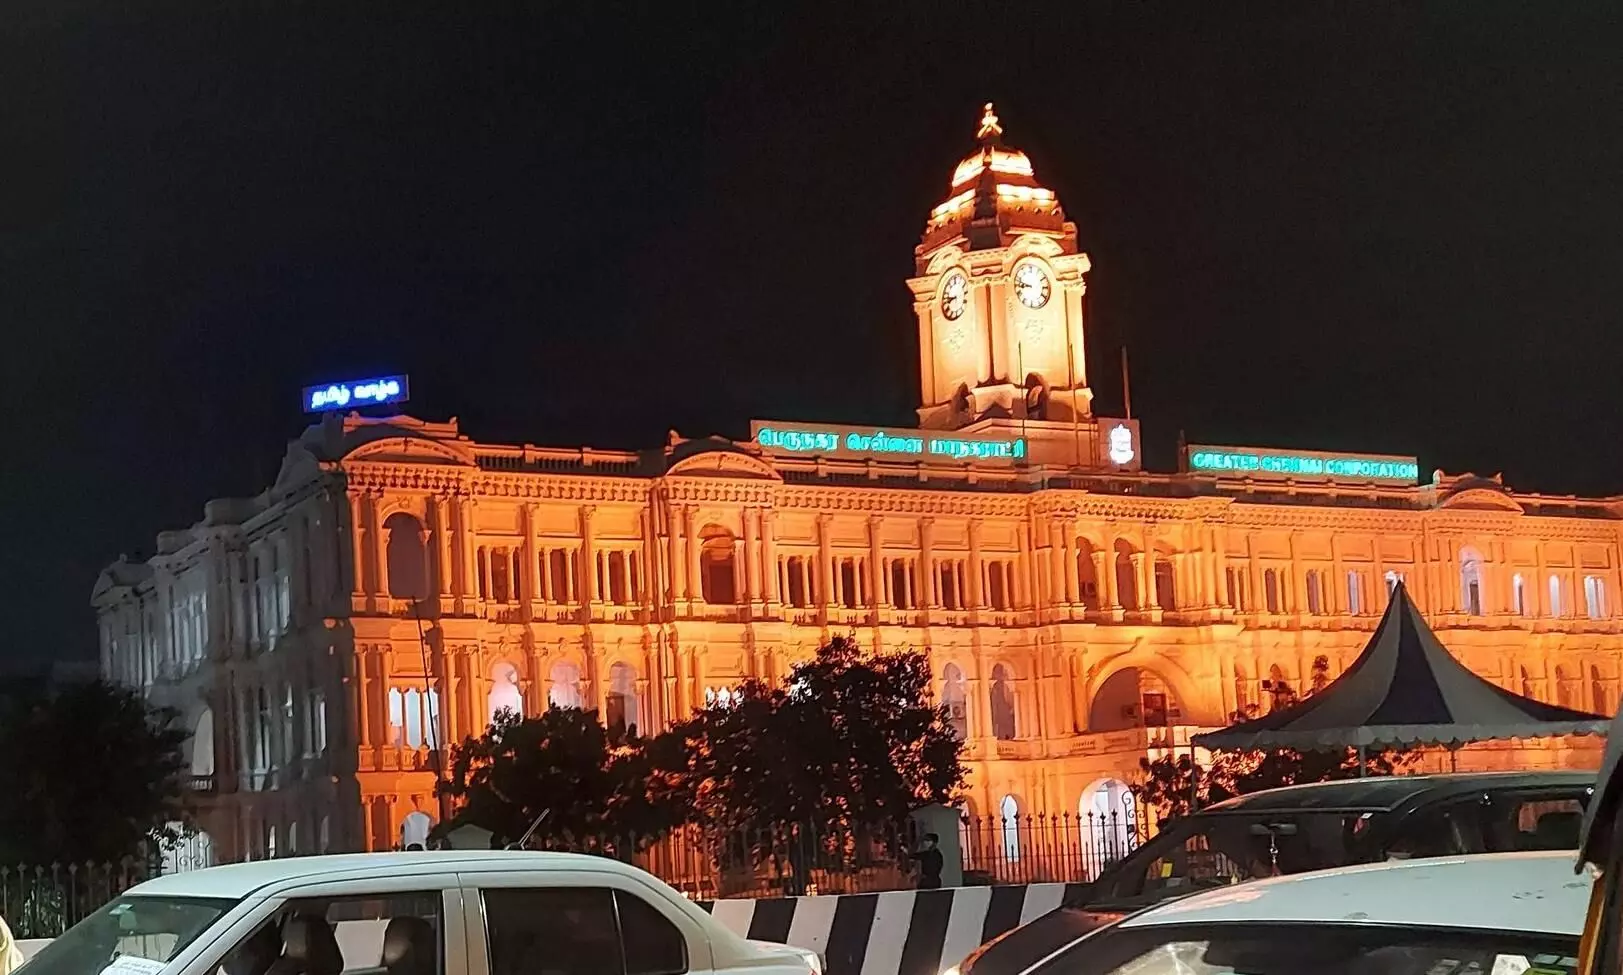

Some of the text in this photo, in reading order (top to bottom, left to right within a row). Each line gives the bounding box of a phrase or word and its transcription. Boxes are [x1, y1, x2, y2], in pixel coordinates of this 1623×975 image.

[846, 431, 924, 453] சென்னை
[1192, 452, 1418, 478] GREATER CHENNAI CORPORATION
